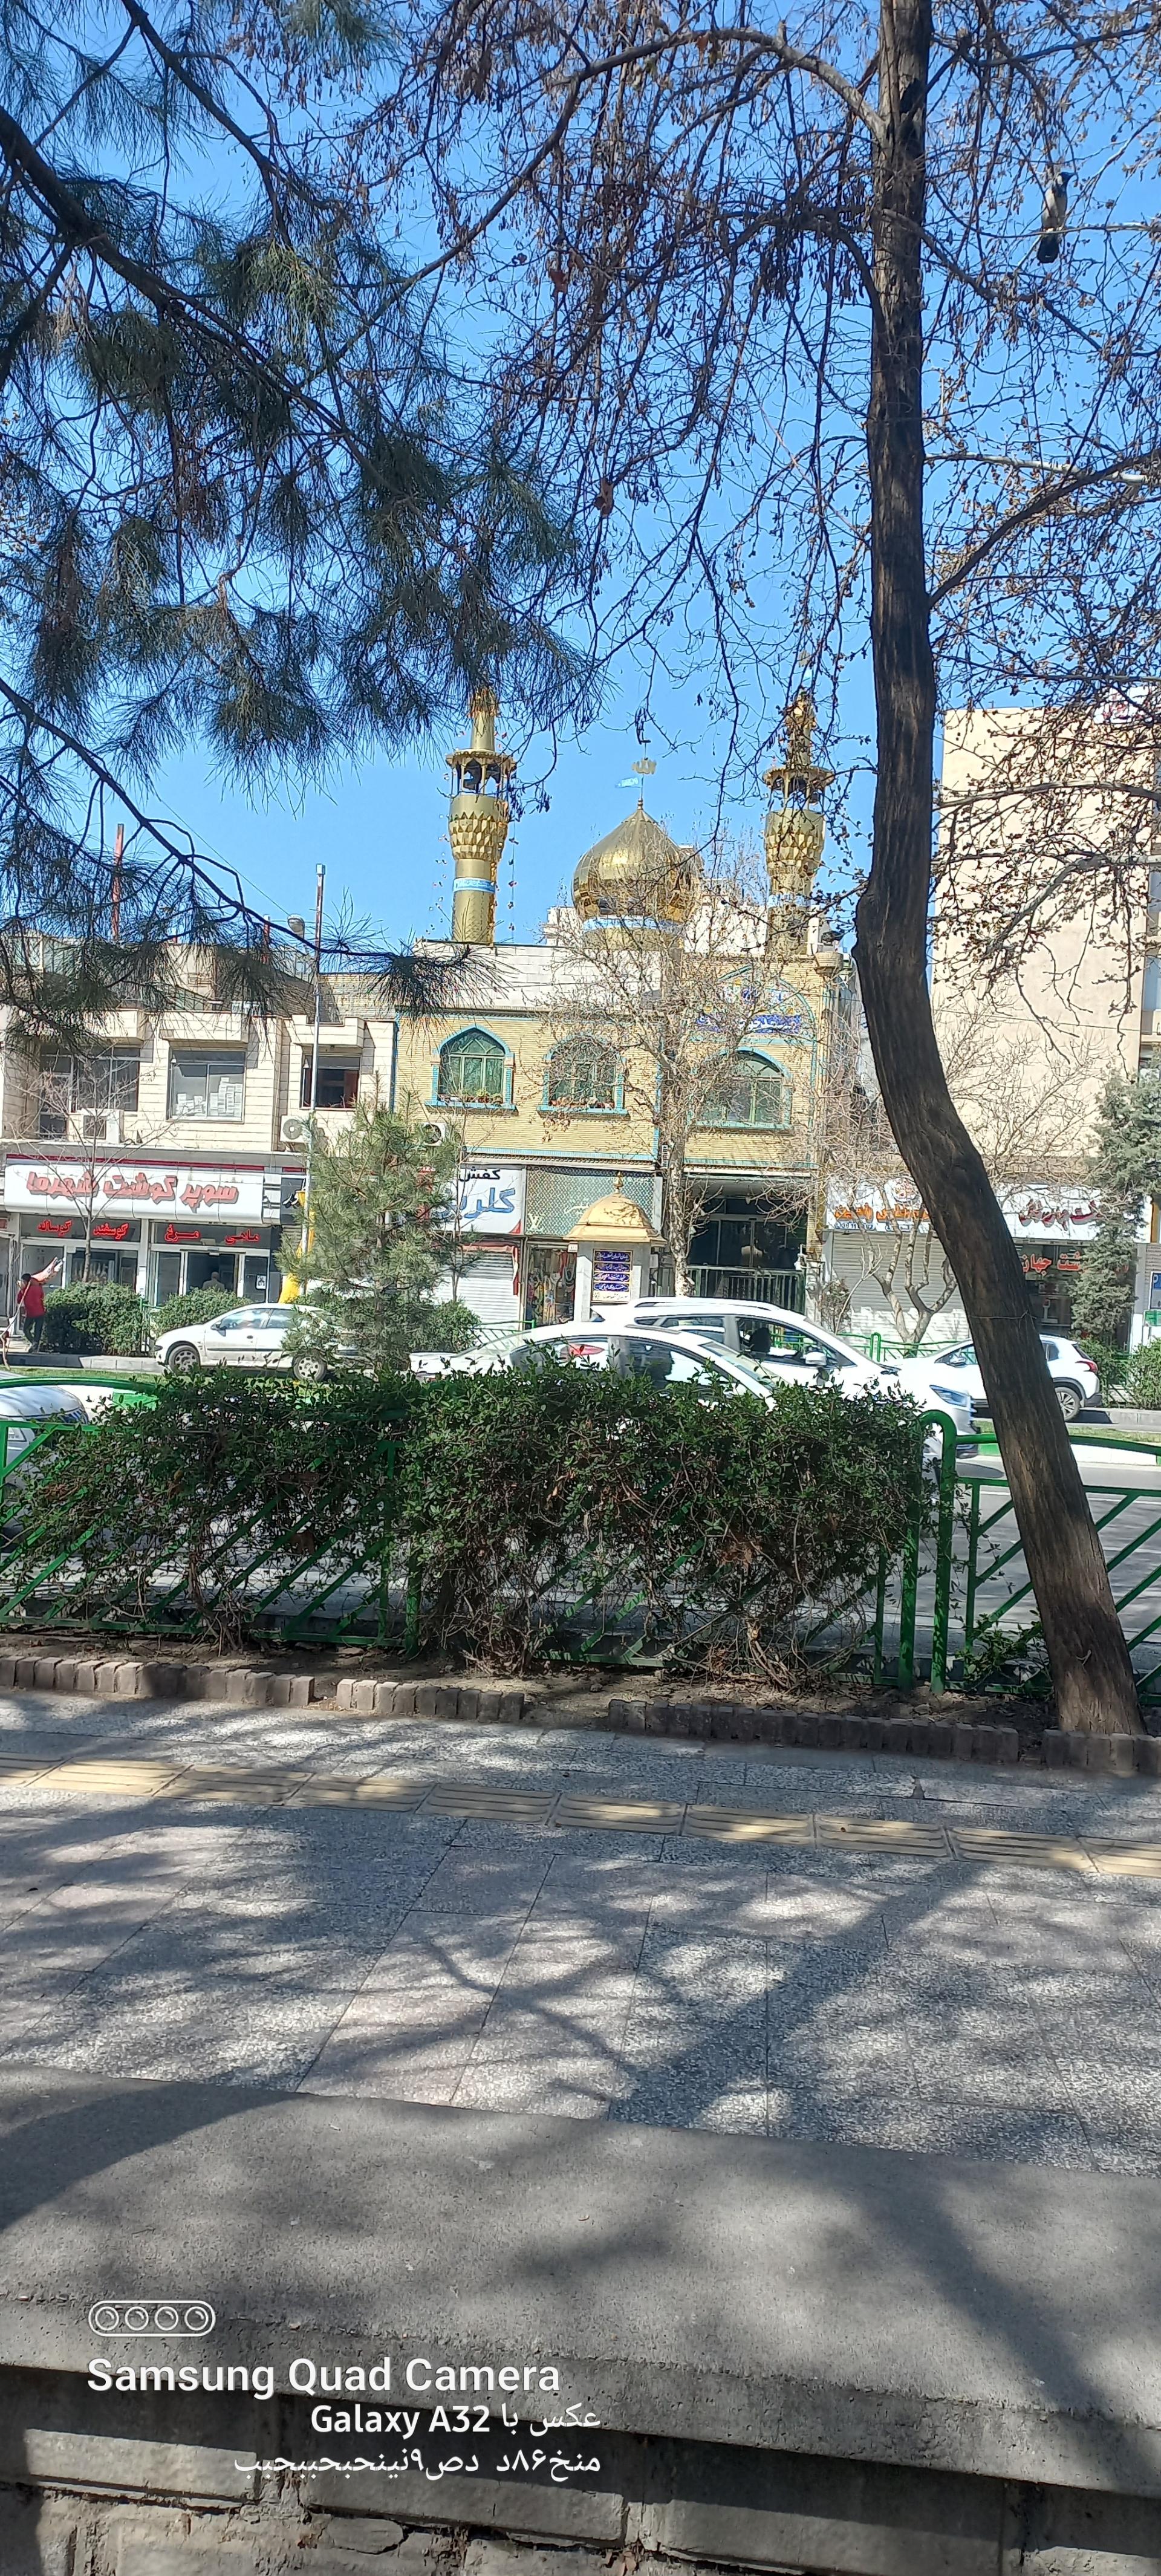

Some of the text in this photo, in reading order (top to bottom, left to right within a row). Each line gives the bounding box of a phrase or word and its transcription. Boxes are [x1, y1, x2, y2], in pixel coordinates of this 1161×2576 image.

[458, 1166, 501, 1182] کفش
[103, 1173, 178, 1205] گوشت
[179, 1184, 238, 1212] سوپر
[37, 1218, 128, 1240] گوسفند گوساله
[164, 1223, 260, 1244] ماهی مرغ
